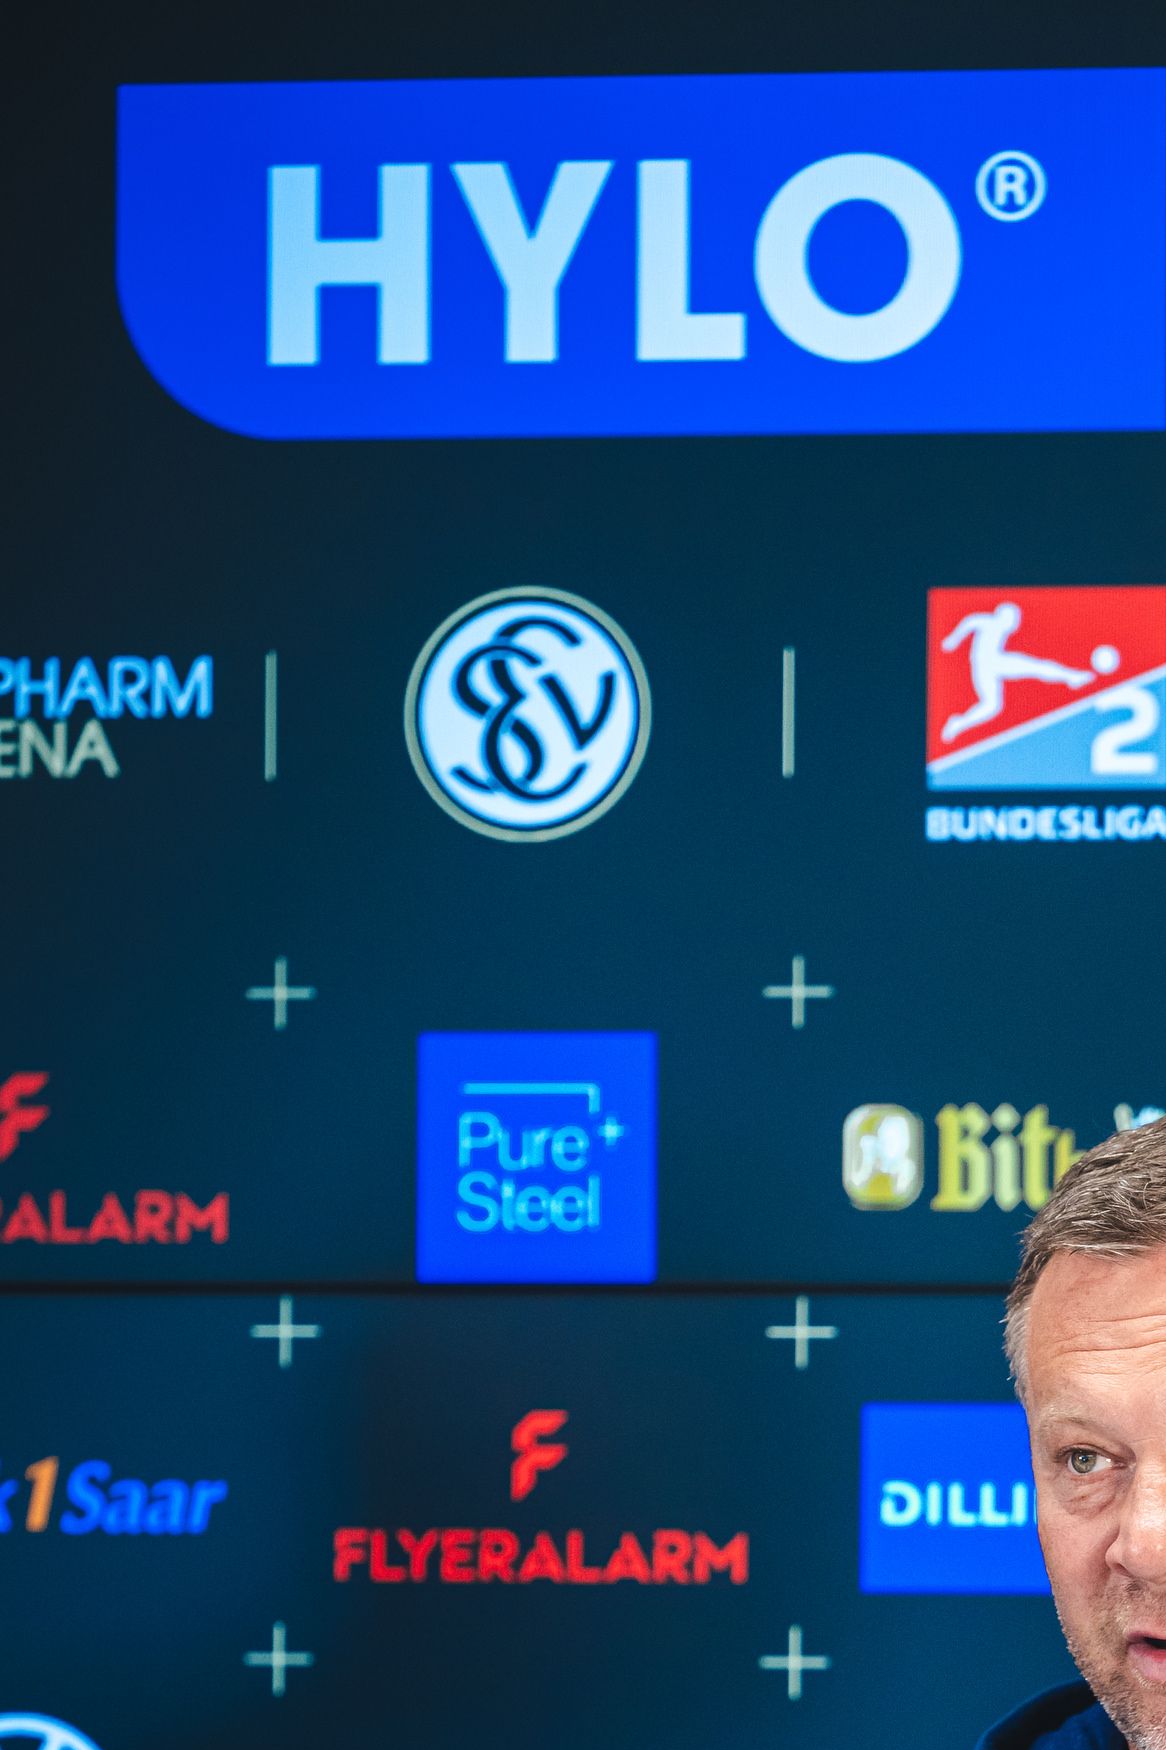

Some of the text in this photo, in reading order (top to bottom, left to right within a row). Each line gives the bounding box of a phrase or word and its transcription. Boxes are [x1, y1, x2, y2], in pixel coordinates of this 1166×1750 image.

[0, 1188, 230, 1244] ALARM
[456, 1172, 601, 1233] Steel
[880, 1480, 1038, 1527] DILLI
[332, 1527, 750, 1586] FLYERALARM
